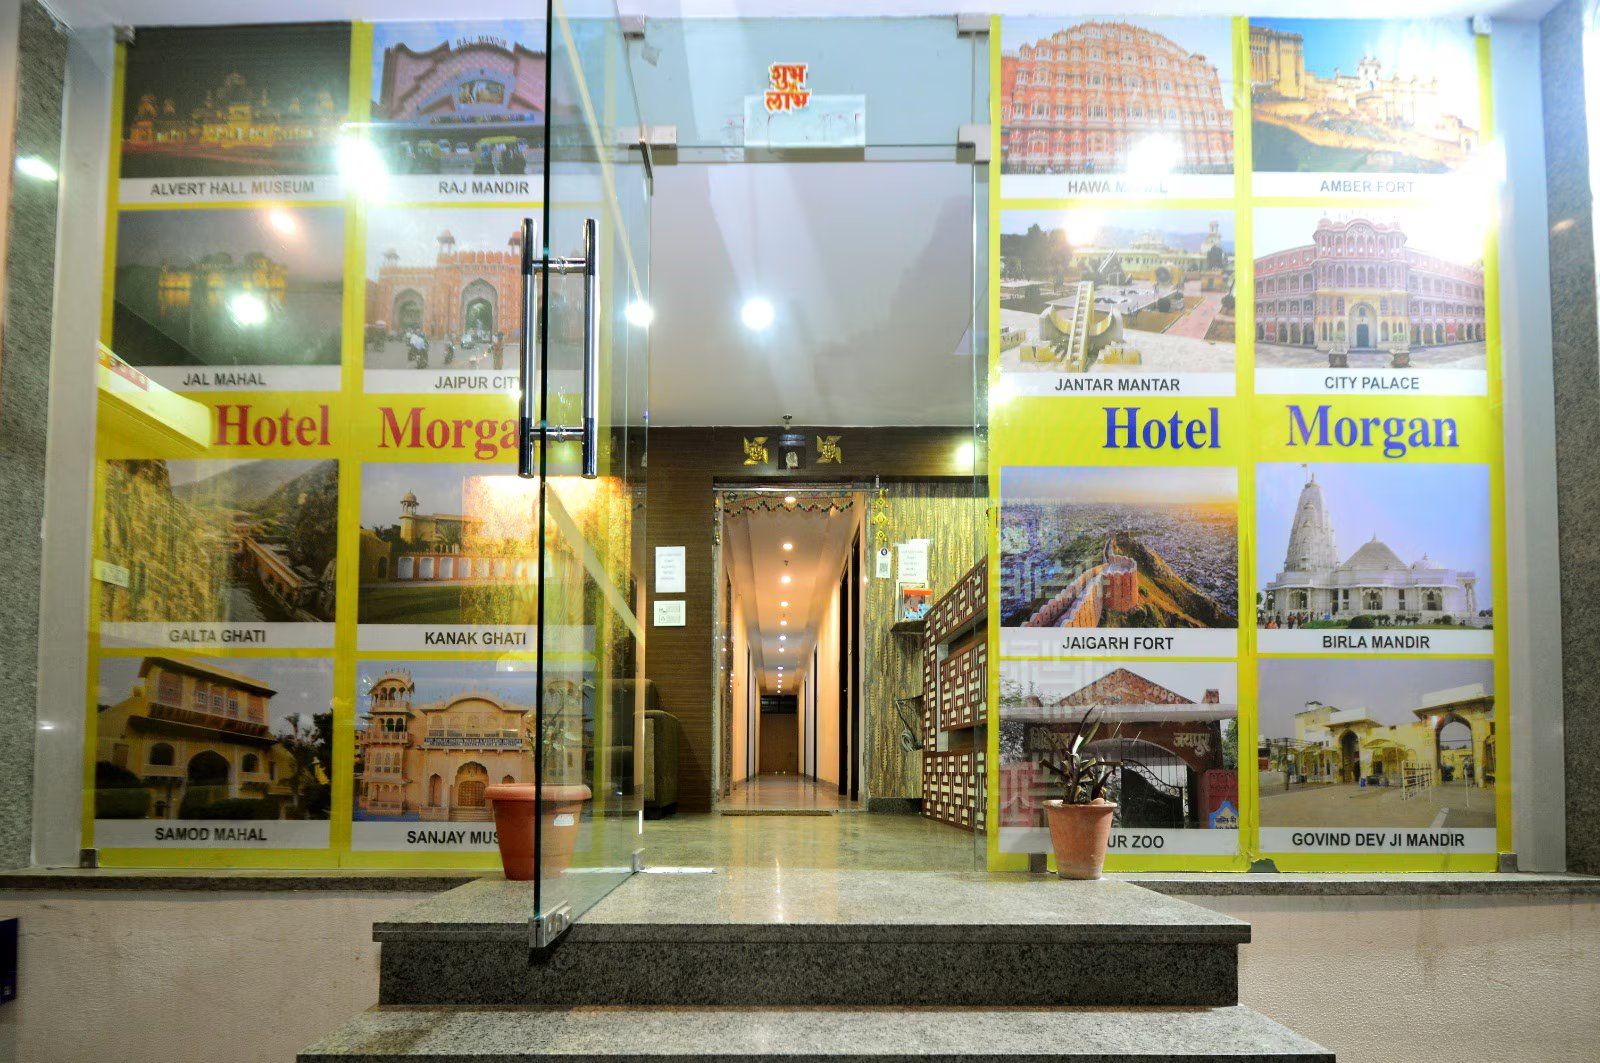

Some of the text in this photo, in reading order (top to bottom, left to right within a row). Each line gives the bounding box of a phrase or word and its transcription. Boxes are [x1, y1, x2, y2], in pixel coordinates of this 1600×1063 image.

[770, 64, 807, 90] शुभ
[764, 91, 811, 112] लाभ
[151, 180, 316, 196] ALVERT HALL MUSEUM
[439, 181, 529, 194] RAJ MANDIR
[1068, 180, 1111, 193] HAWA
[1320, 180, 1416, 193] AMBER FORT
[182, 373, 267, 386] JAL MAHAL
[435, 376, 489, 389] JAIPUR
[1055, 378, 1180, 391] JANTAR MANTAR
[1324, 376, 1420, 390] CITY PALACE
[214, 404, 528, 461] Hotel Morga
[1102, 405, 1459, 459] Hotel Morgan
[169, 629, 266, 643] GALTA GHATI
[425, 631, 527, 645] KANAK GHATI
[1062, 636, 1174, 650] JAIGARH FORT
[1322, 635, 1431, 649] BIRLA MANDIR
[155, 827, 268, 841] SAMOD MAHAL
[407, 830, 466, 844] SANJAY
[1291, 832, 1465, 847] GOVIND DEV JI MANDIR
[1132, 834, 1165, 849] ZOO
